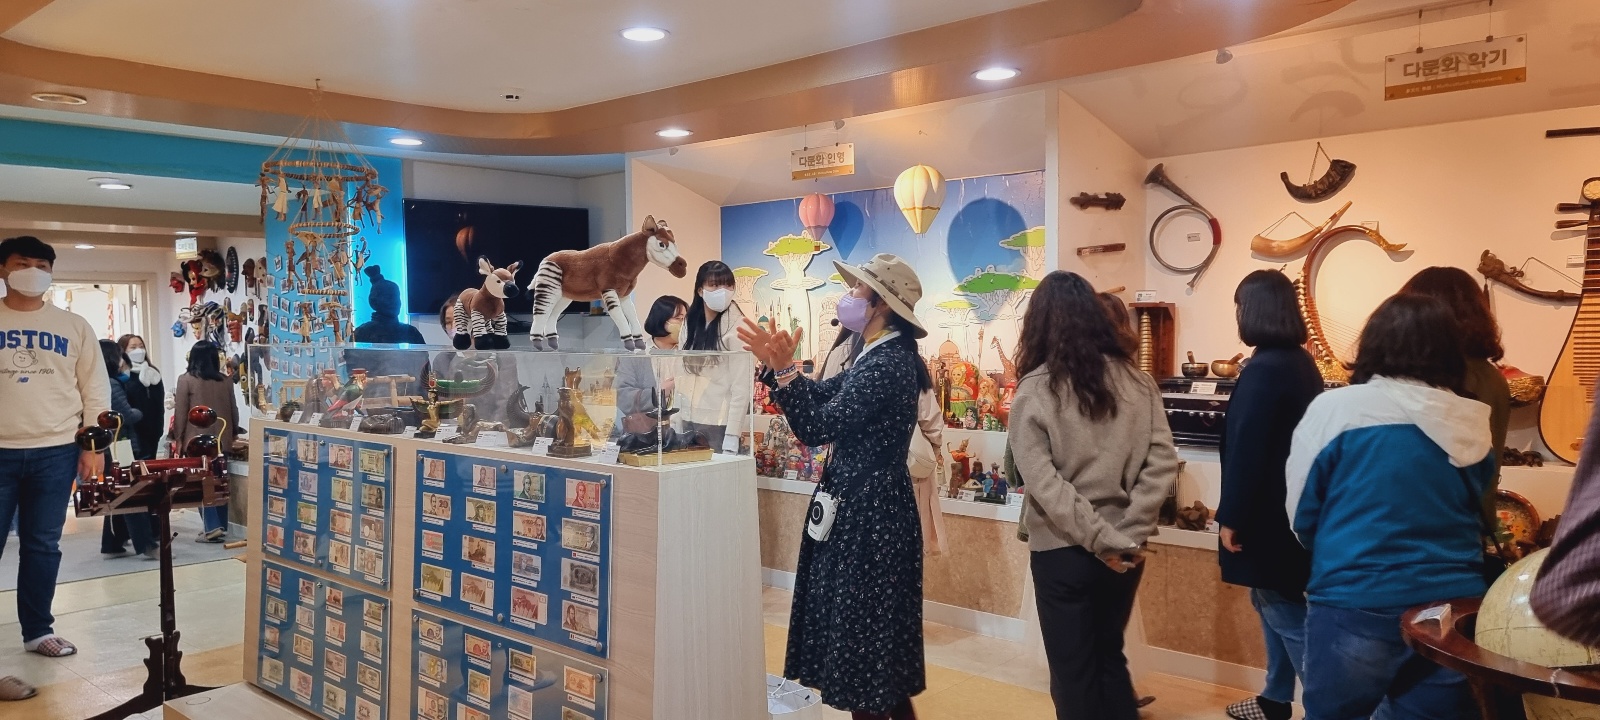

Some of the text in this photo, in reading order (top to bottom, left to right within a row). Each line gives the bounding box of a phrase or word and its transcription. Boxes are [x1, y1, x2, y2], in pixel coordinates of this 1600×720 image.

[1403, 48, 1507, 78] 다문화 악기
[799, 152, 845, 167] 다문화 인형
